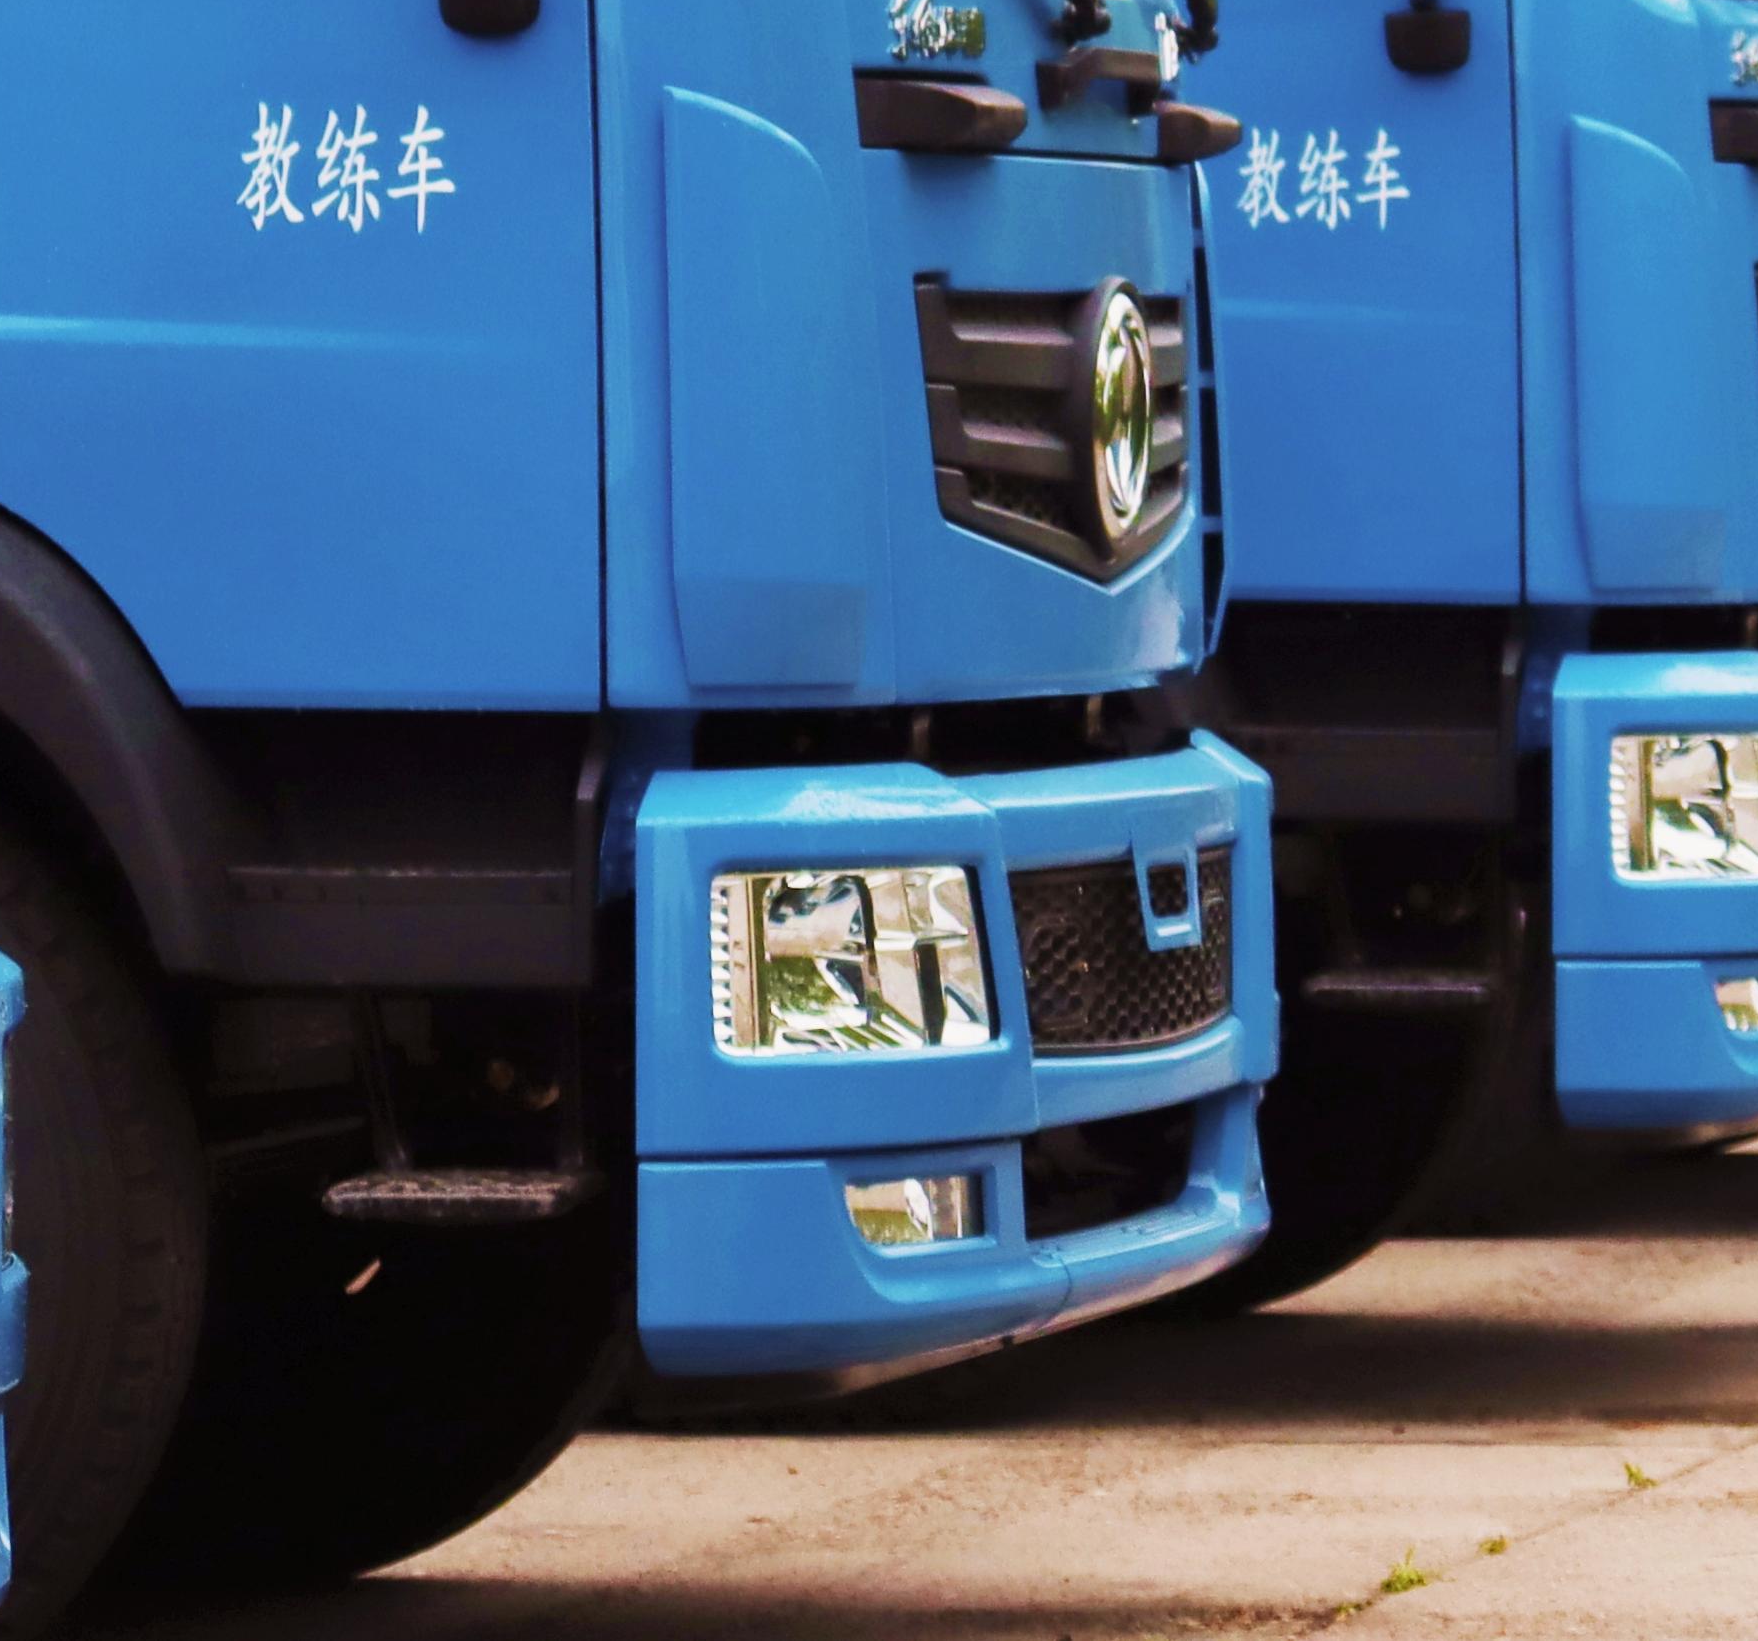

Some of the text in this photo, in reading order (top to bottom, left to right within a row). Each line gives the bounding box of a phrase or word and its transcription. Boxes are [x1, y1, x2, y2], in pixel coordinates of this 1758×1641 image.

[236, 101, 456, 234] 教练车
[1237, 127, 1410, 230] 教练车
